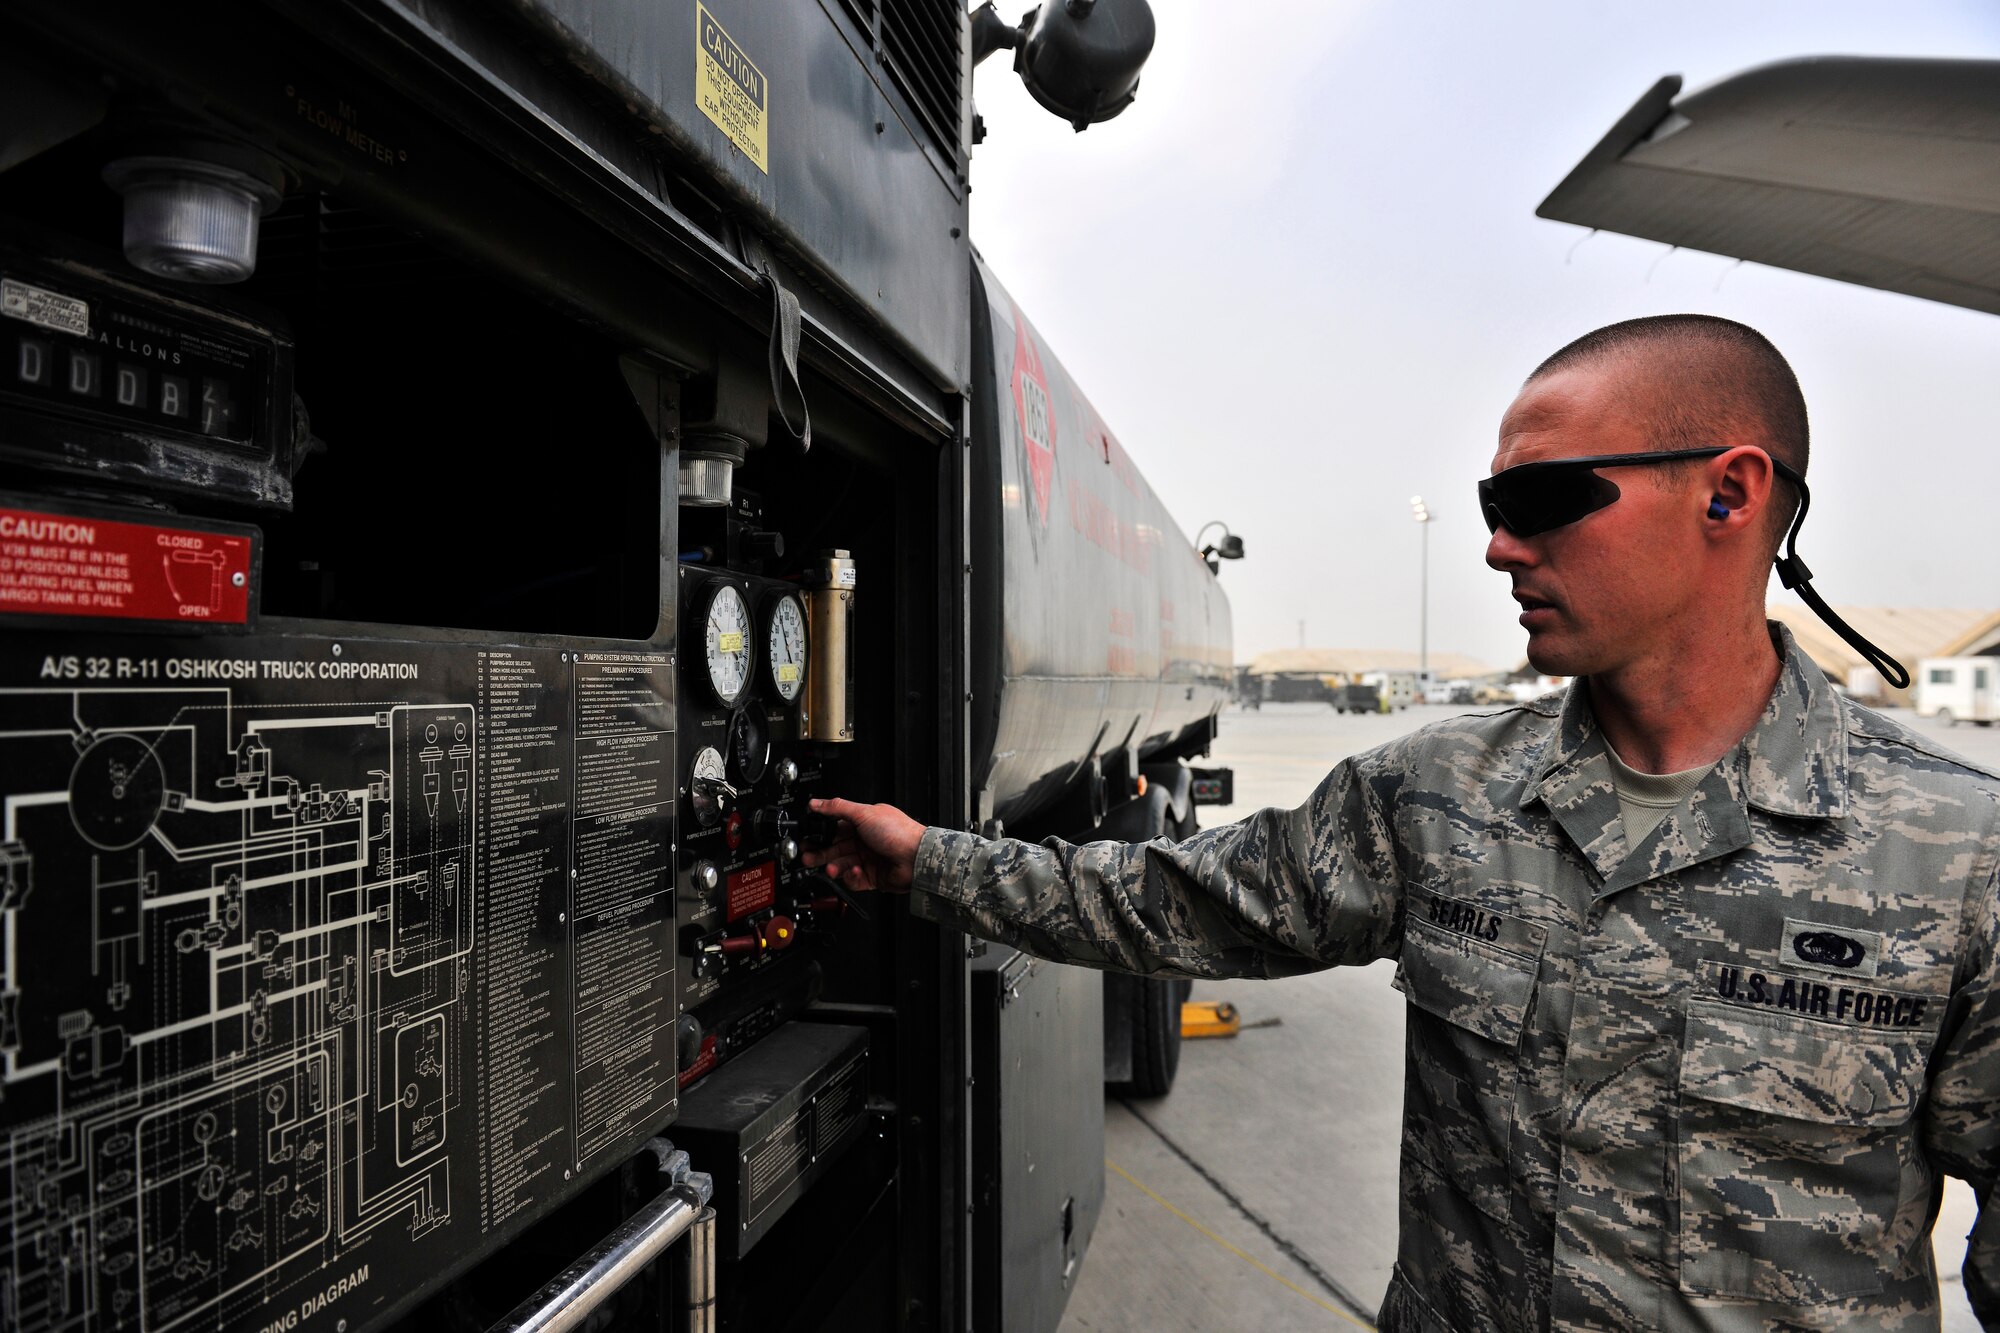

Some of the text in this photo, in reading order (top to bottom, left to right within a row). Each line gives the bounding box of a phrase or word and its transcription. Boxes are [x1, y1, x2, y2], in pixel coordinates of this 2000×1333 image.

[706, 24, 758, 98] CAUTION
[705, 55, 760, 122] DO NOT OPERATE
[706, 69, 722, 93] THIS
[723, 89, 760, 131] EQUIPMENT
[704, 95, 719, 118] EAR
[722, 113, 760, 158] PROTECTION
[719, 96, 748, 133] WITHOUT
[297, 97, 395, 167] FLOW METER
[742, 498, 749, 509] R1
[0, 516, 95, 545] CAUTION
[157, 534, 204, 550] CLOSED
[30, 545, 67, 560] MUST
[70, 548, 87, 562] BE
[90, 550, 103, 564] IN
[105, 551, 129, 567] THE
[15, 557, 78, 576] POSITION
[80, 563, 130, 580] UNLESS
[61, 576, 94, 592] FUEL
[96, 579, 133, 595] WHEN
[42, 589, 73, 605] TANK
[77, 591, 90, 606] IS
[93, 592, 125, 608] FULL
[179, 604, 210, 618] OPEN
[41, 656, 419, 680] A/S 32 R-11 OSHKOSH TRUCK CORPORATION
[584, 653, 666, 663] PUMPING SYSTEM OPERATING INSTRUCTIONS
[602, 666, 628, 674] PRELIMINARY
[596, 735, 658, 747] HIGH FLOW PUMPING PROCEDURE
[595, 806, 657, 825] LOW FLOW PUMPING PROCEDURE
[741, 868, 762, 884] CAUTION
[597, 897, 654, 922] DEFUEL PUMPING PROCEDURE
[1429, 896, 1503, 942] SEARLS
[629, 982, 652, 999] PROCEDURE
[1777, 978, 1831, 1016] AIR
[1836, 988, 1930, 1028] FORCE
[602, 1034, 653, 1067] PUMP PRIMING PROCEDURE
[605, 1093, 653, 1129] EMERGENCY PROCEDURE
[302, 1264, 369, 1320] DIAGRAM
